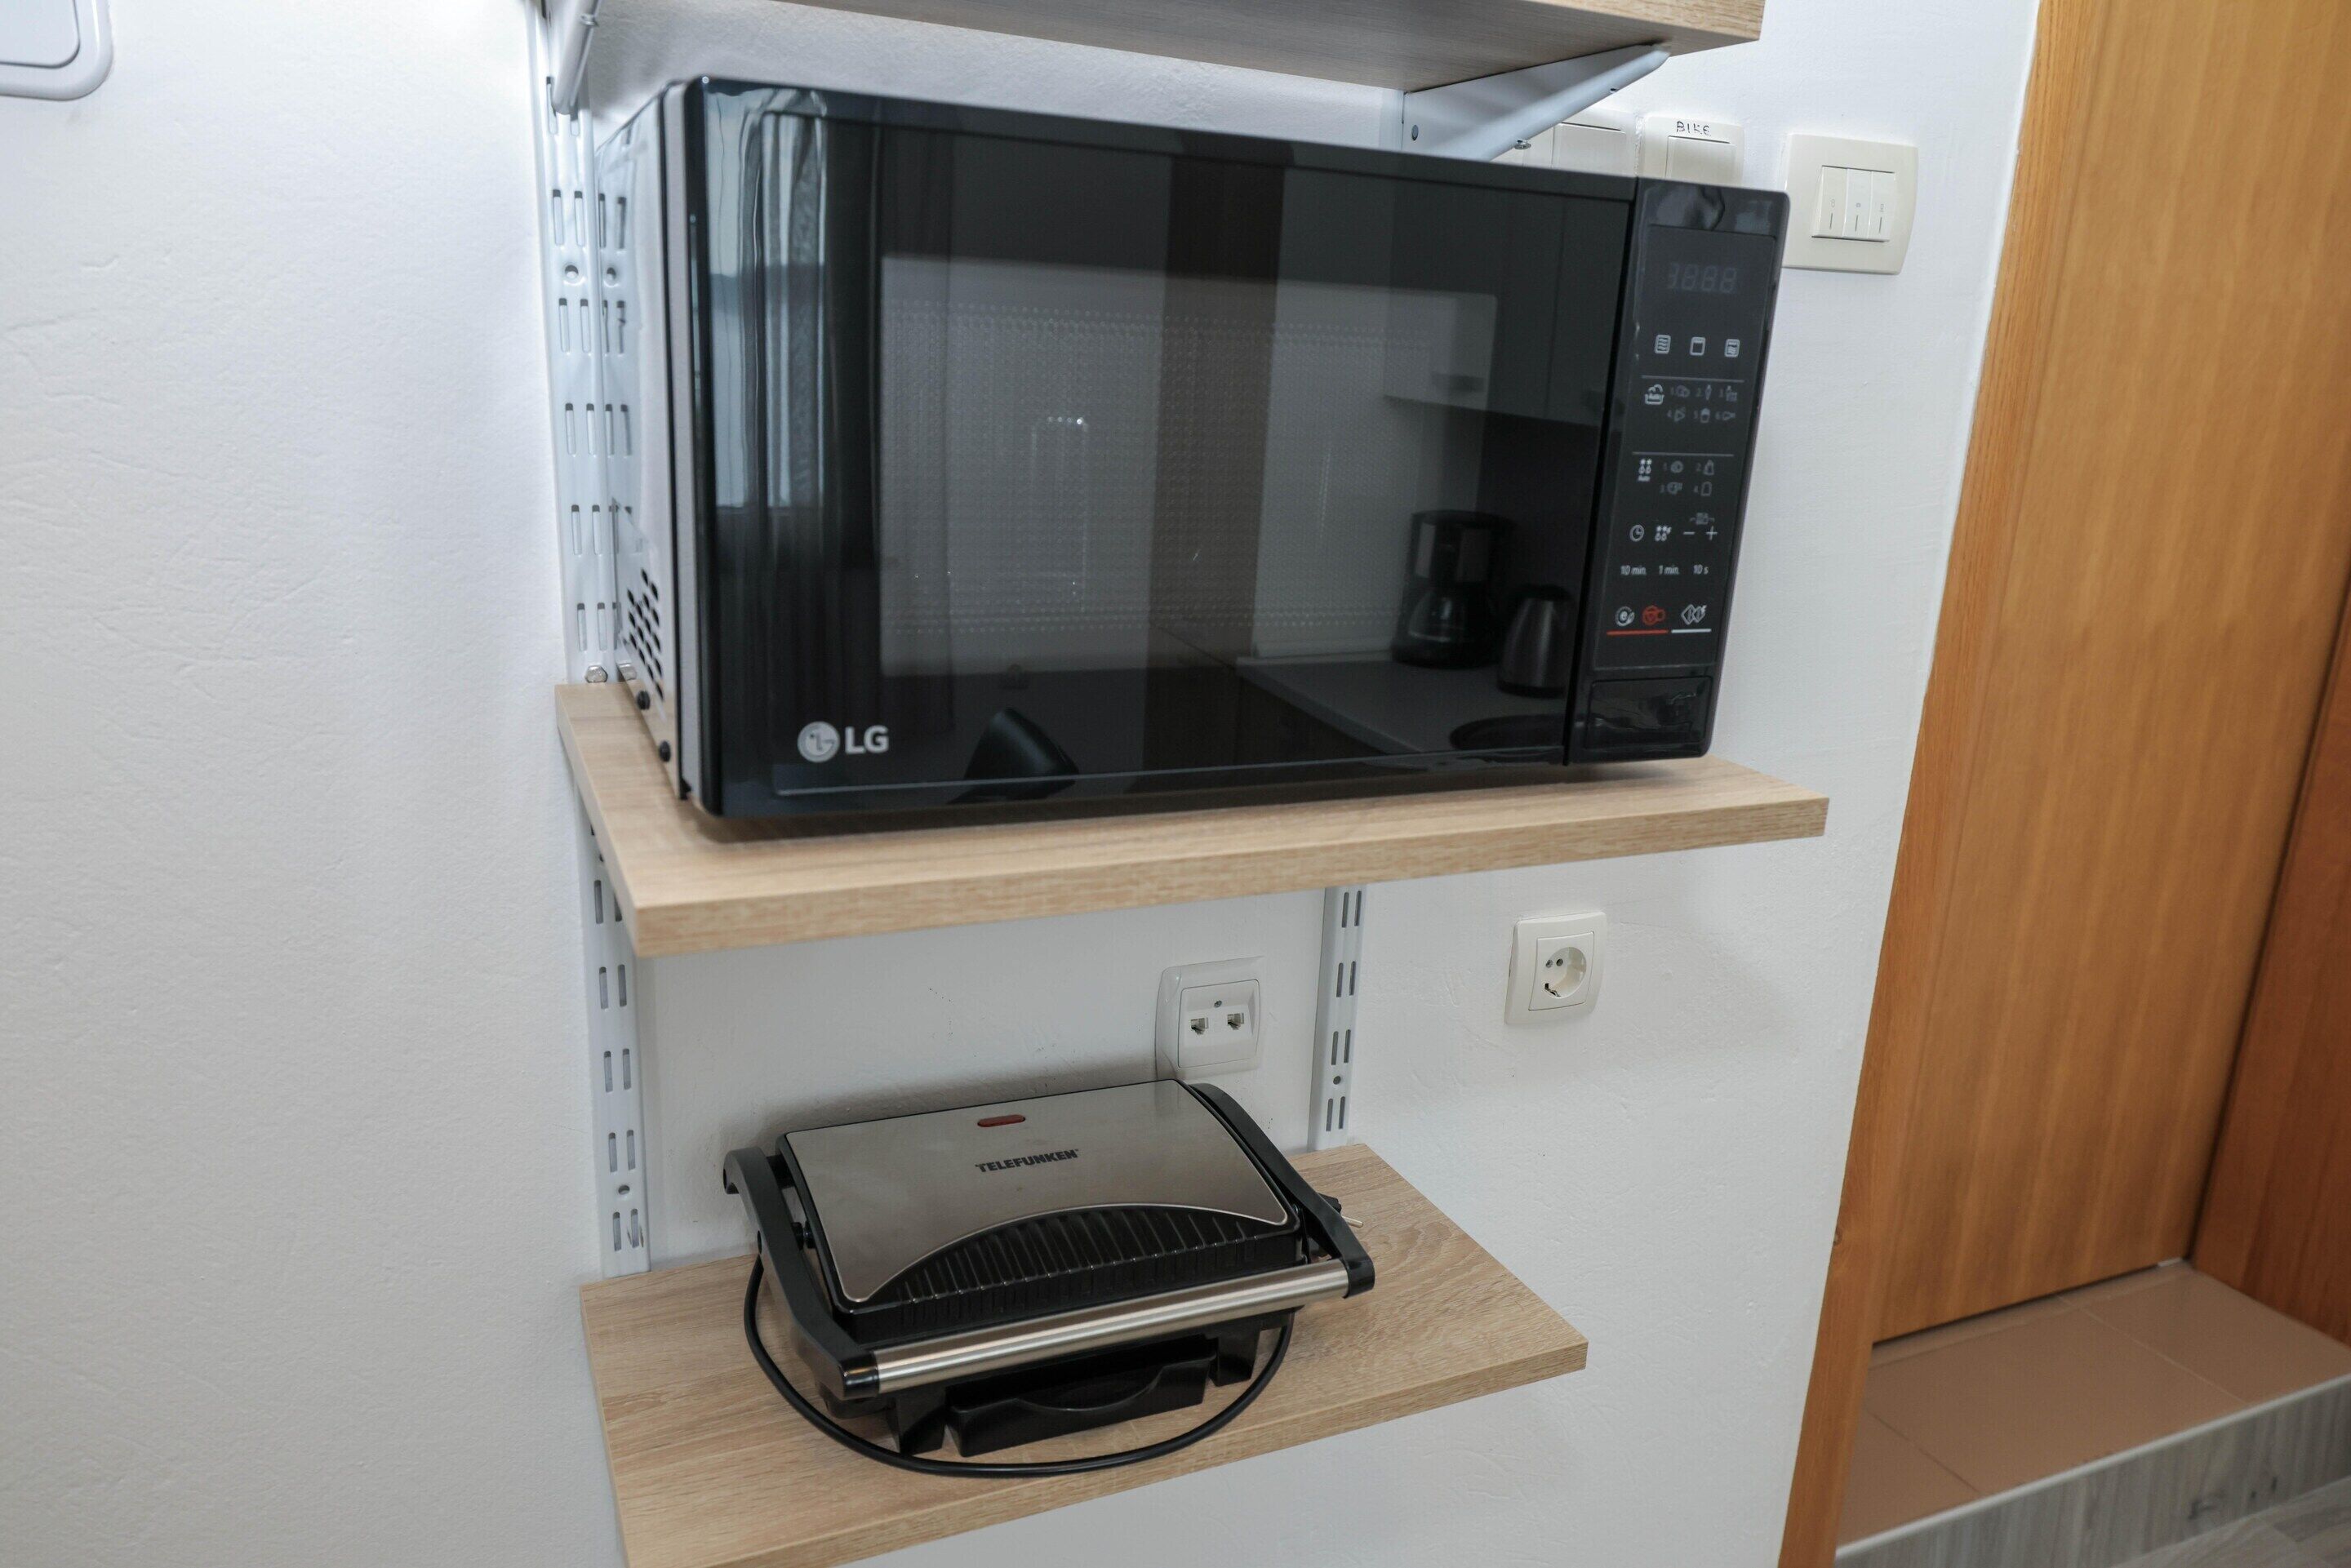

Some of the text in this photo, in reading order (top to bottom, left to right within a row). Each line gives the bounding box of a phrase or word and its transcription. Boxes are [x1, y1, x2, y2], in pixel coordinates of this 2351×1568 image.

[1676, 120, 1711, 136] BIKE
[1620, 565, 1631, 575] 10
[1693, 564, 1703, 575] 10
[844, 724, 890, 755] LG
[975, 1148, 1078, 1172] TELEFUNKEN
